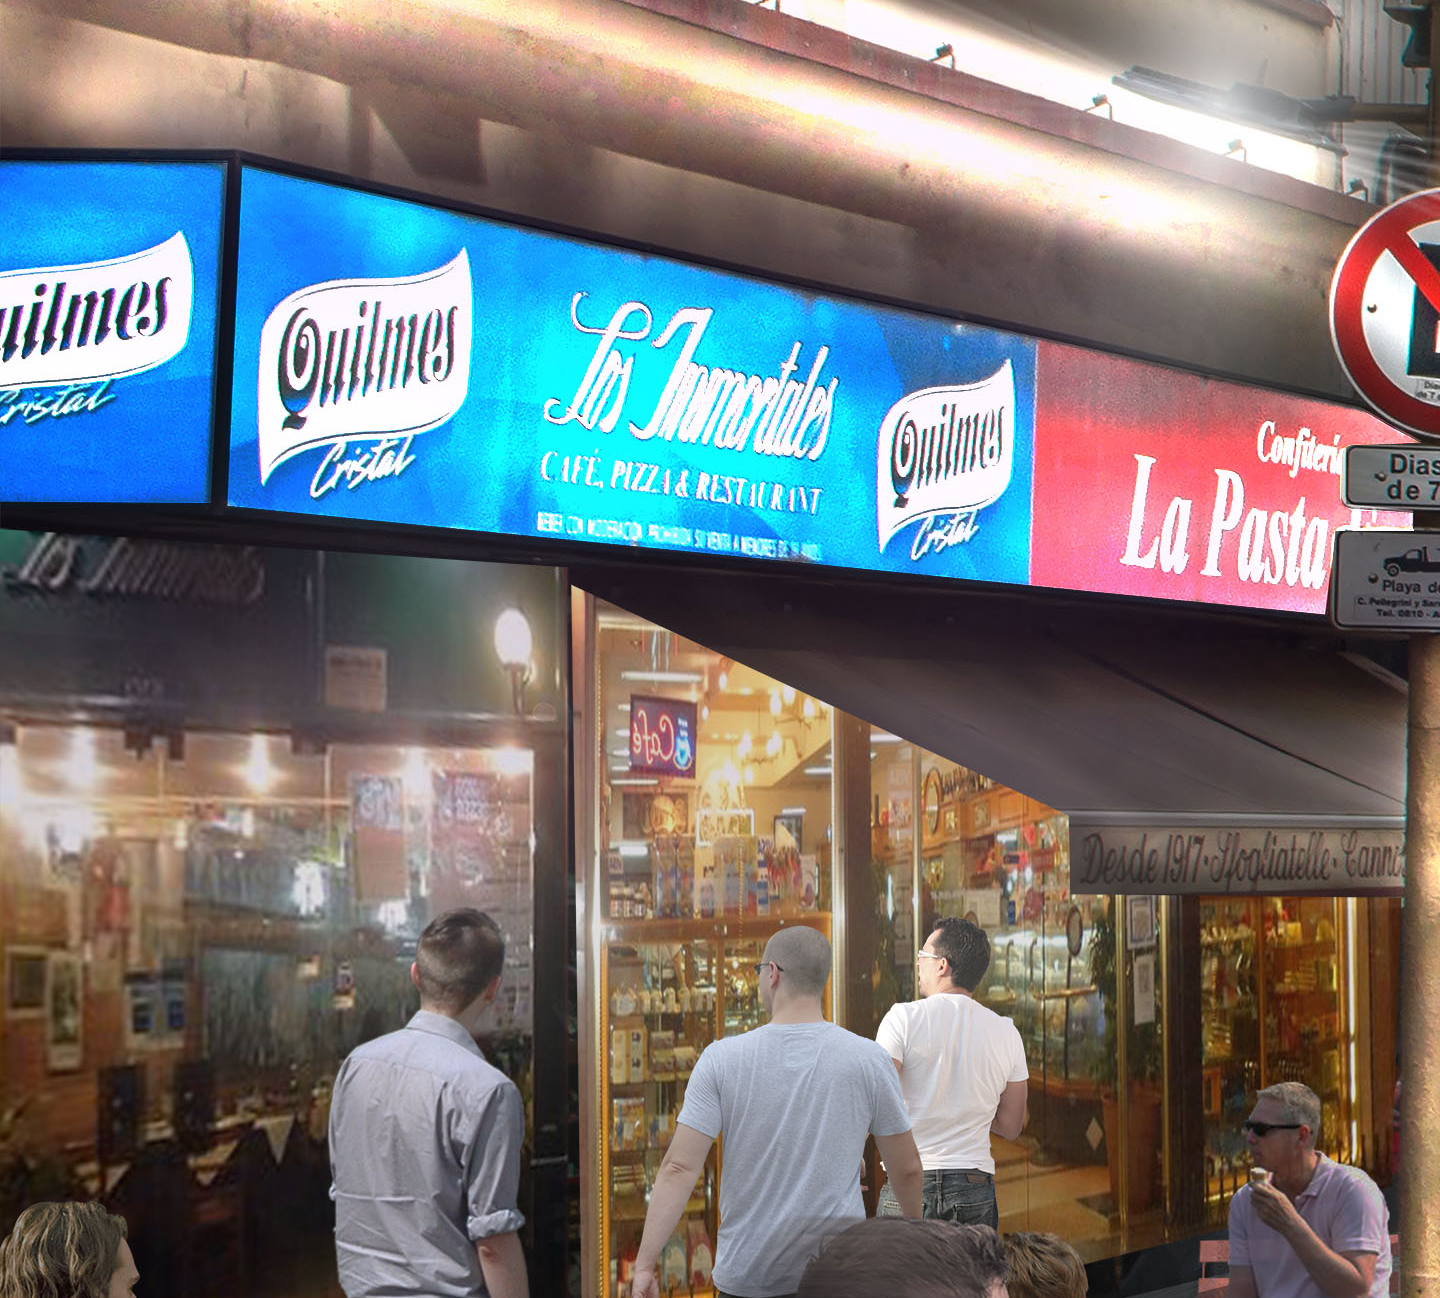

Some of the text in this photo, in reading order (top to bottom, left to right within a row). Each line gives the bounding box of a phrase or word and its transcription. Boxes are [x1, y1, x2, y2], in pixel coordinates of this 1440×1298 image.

[0, 276, 173, 362] uilmes
[278, 301, 460, 430] Quilmes
[543, 290, 653, 436] Los
[309, 435, 417, 499] Cristal
[892, 402, 1006, 509] Quilmes
[609, 460, 672, 497] PIZZA
[672, 470, 691, 501] &
[695, 473, 825, 517] RESTAURANT
[1386, 479, 1421, 501] de
[910, 511, 979, 562] Cristal
[1122, 453, 1330, 590] La Pasta
[1382, 579, 1422, 594] Playa
[1080, 832, 1158, 886] Desde
[1162, 833, 1206, 884] 1917
